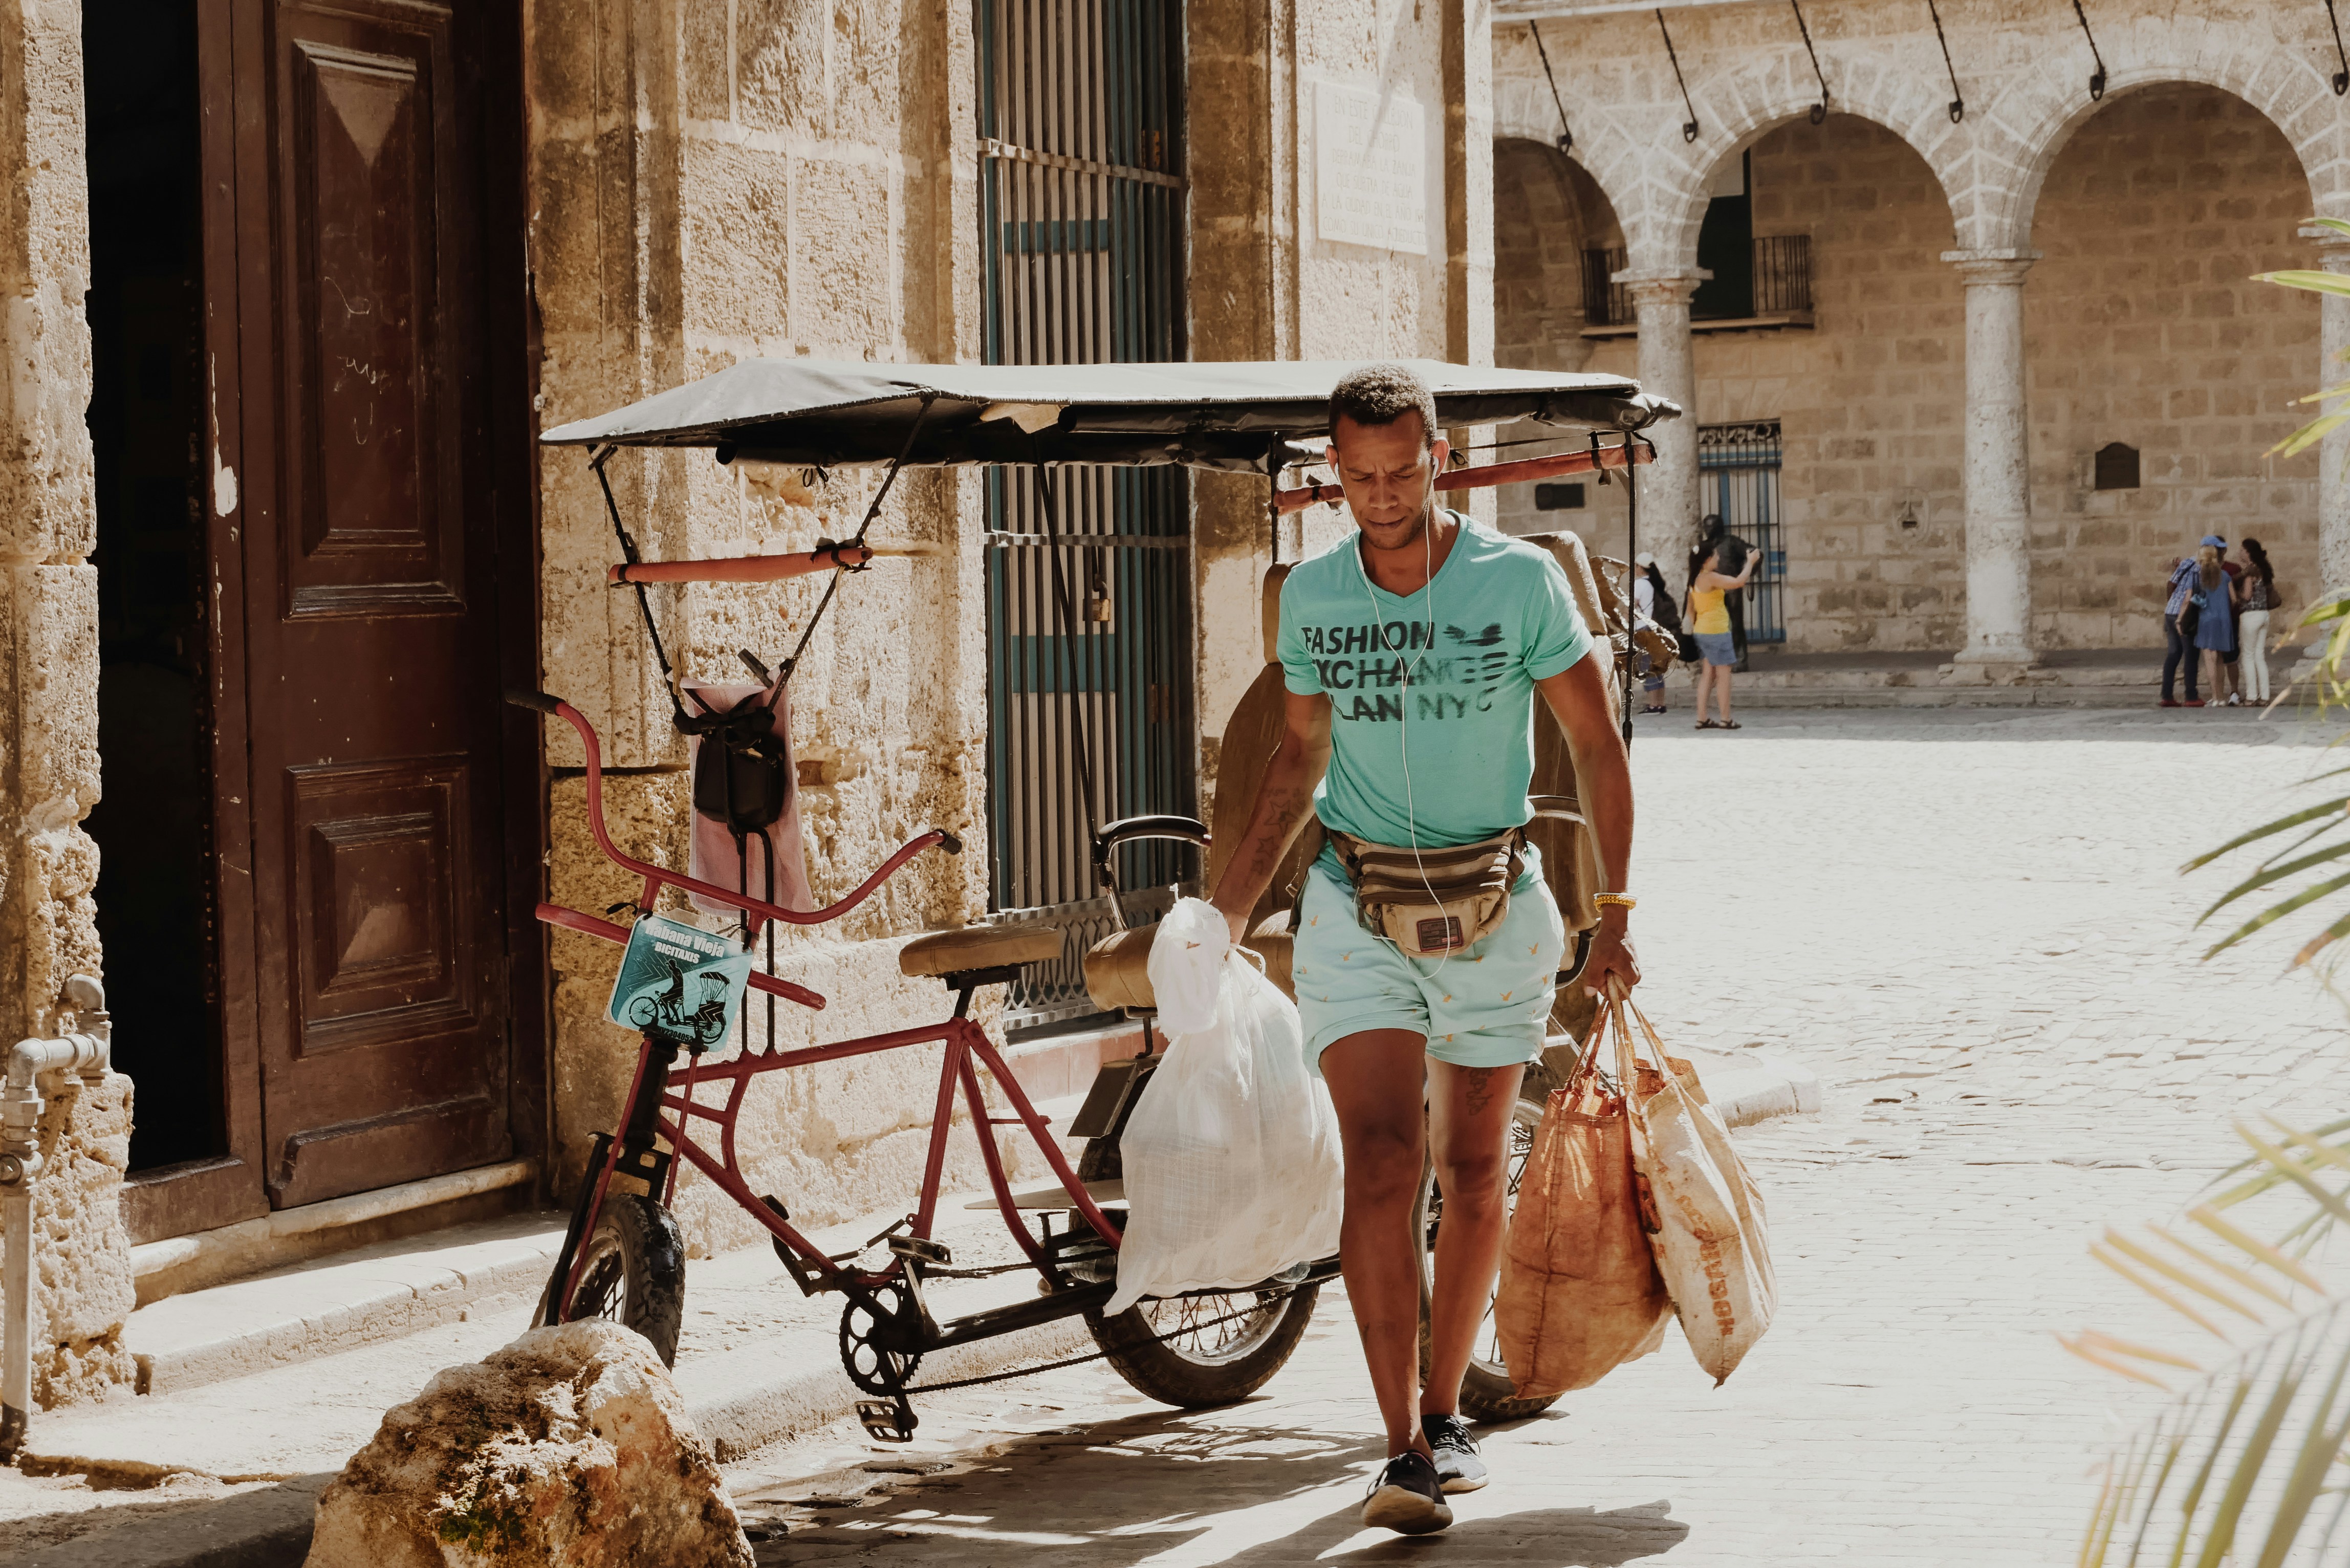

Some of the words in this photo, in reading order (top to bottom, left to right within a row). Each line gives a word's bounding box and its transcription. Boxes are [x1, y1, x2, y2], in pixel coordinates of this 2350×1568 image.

[1335, 95, 1345, 115] EN
[1349, 99, 1368, 120] ESTE
[1348, 125, 1362, 145] DEL
[1380, 157, 1388, 172] LA
[1392, 160, 1416, 178] ZANJA
[1336, 172, 1350, 188] QUE
[1354, 176, 1378, 193] SURTIA
[1382, 180, 1389, 195] DE
[1393, 182, 1412, 200] AGUA
[1322, 192, 1328, 208] A
[1332, 194, 1342, 209] LA
[1345, 197, 1370, 215] CIUDAD
[1374, 202, 1382, 217] EN
[1386, 204, 1392, 219] EL
[1396, 203, 1411, 221] AÑO
[1323, 216, 1346, 233] COMO
[1351, 221, 1359, 235] SU
[1363, 223, 1383, 239] UNICO
[1301, 621, 1435, 655] FASHION
[1417, 686, 1498, 721] NYC
[645, 923, 692, 947] Habana
[693, 935, 725, 958] Vieja
[654, 941, 700, 964] BICITAXIS
